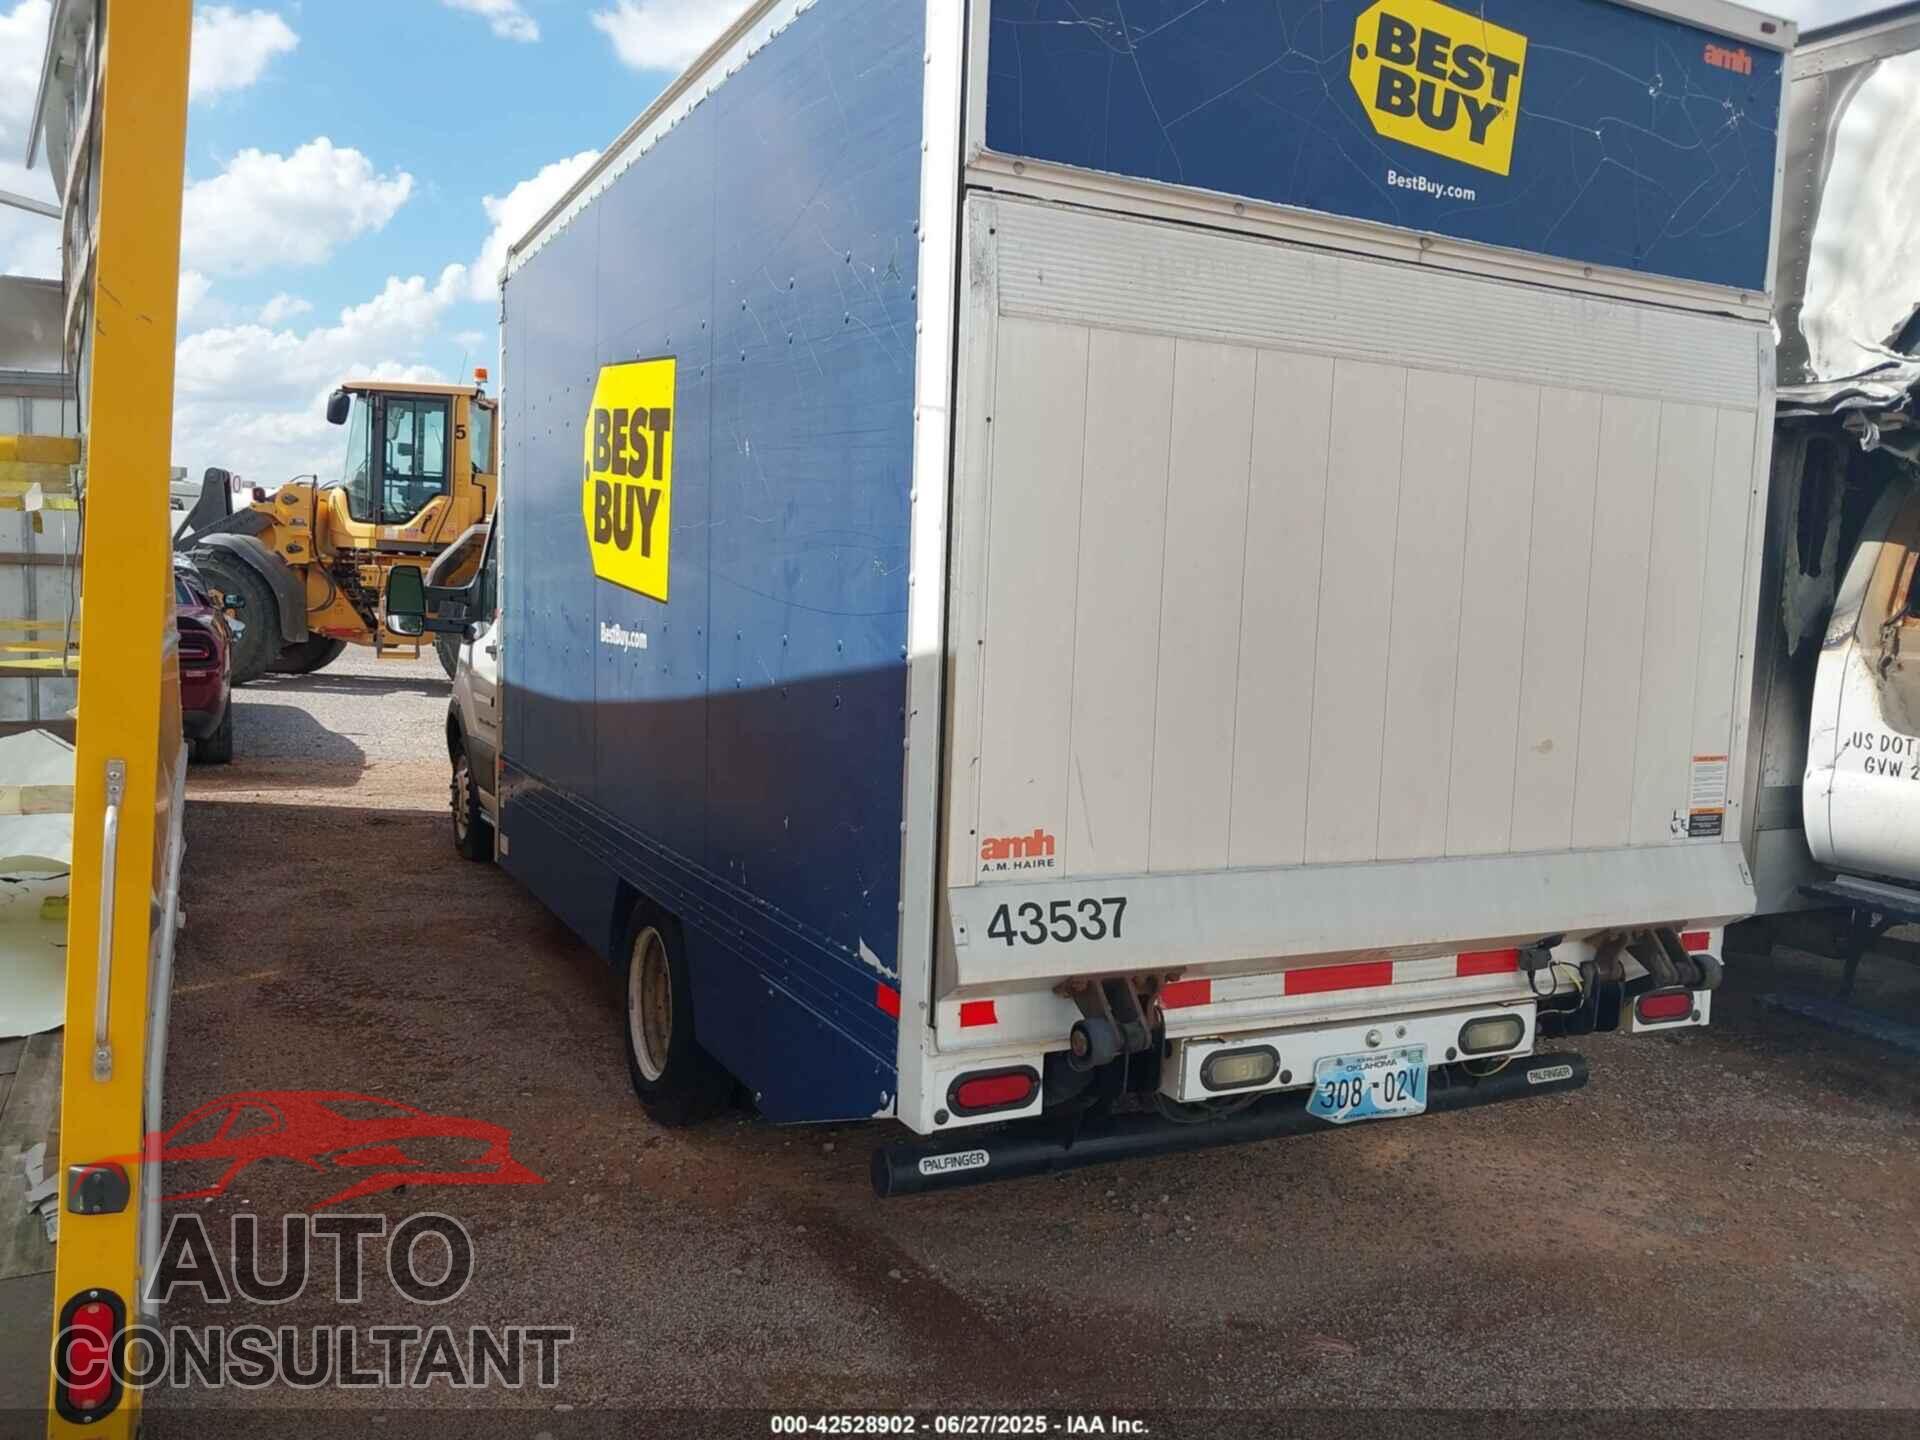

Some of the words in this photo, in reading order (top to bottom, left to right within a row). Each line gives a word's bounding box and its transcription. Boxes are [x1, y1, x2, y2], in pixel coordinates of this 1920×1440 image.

[1375, 12, 1520, 102] BEST
[1703, 43, 1752, 75] amh
[1375, 65, 1504, 145] BUY
[1387, 169, 1476, 201] BestBuy.com
[456, 424, 466, 440] 5
[593, 407, 671, 481] BEST
[594, 479, 662, 559] BUY
[600, 621, 648, 653] BestBuy.com
[1852, 731, 1874, 750] US
[1880, 734, 1916, 756] DOT
[1864, 756, 1904, 777] GVW
[981, 829, 1056, 860] amh
[1013, 858, 1056, 871] HAIRE
[986, 896, 1128, 947] 43537
[1345, 1058, 1398, 1072] OKLAHOMA
[922, 1151, 986, 1172] PALFINGER
